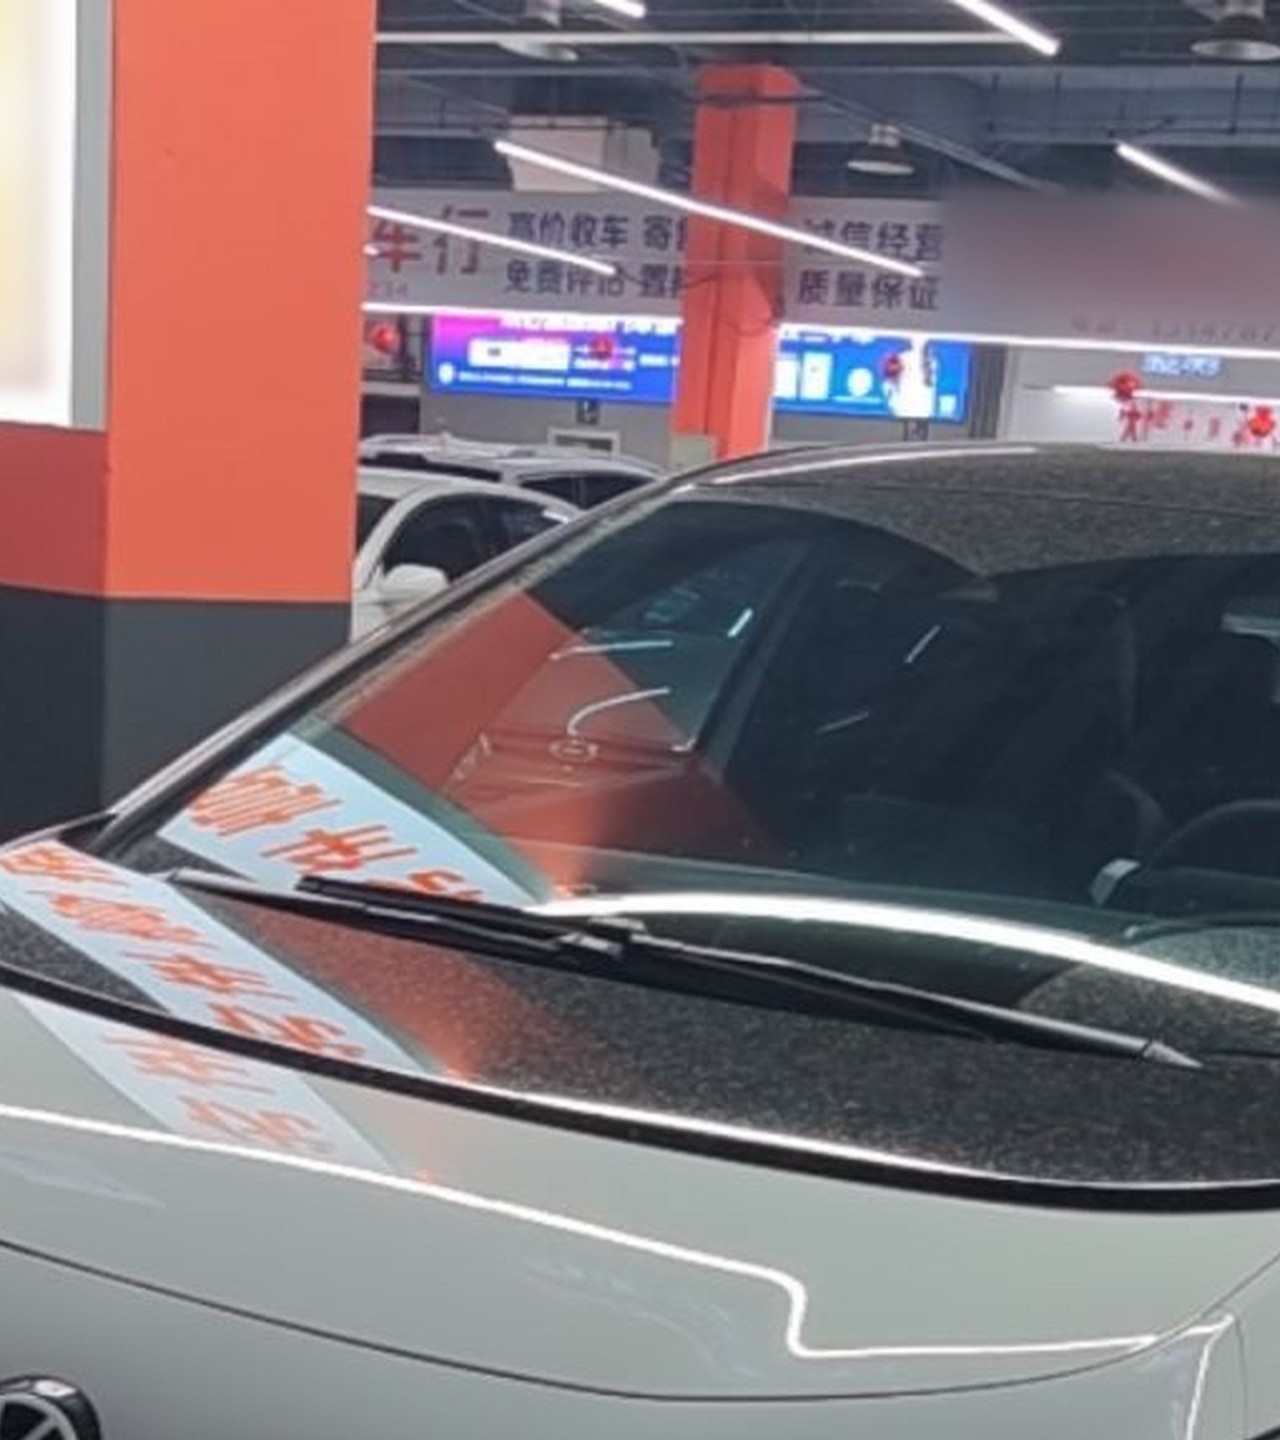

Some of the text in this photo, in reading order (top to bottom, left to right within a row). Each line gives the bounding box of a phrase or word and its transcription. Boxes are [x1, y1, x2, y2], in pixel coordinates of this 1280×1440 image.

[642, 214, 687, 250] 寄
[798, 269, 940, 311] 质量保证
